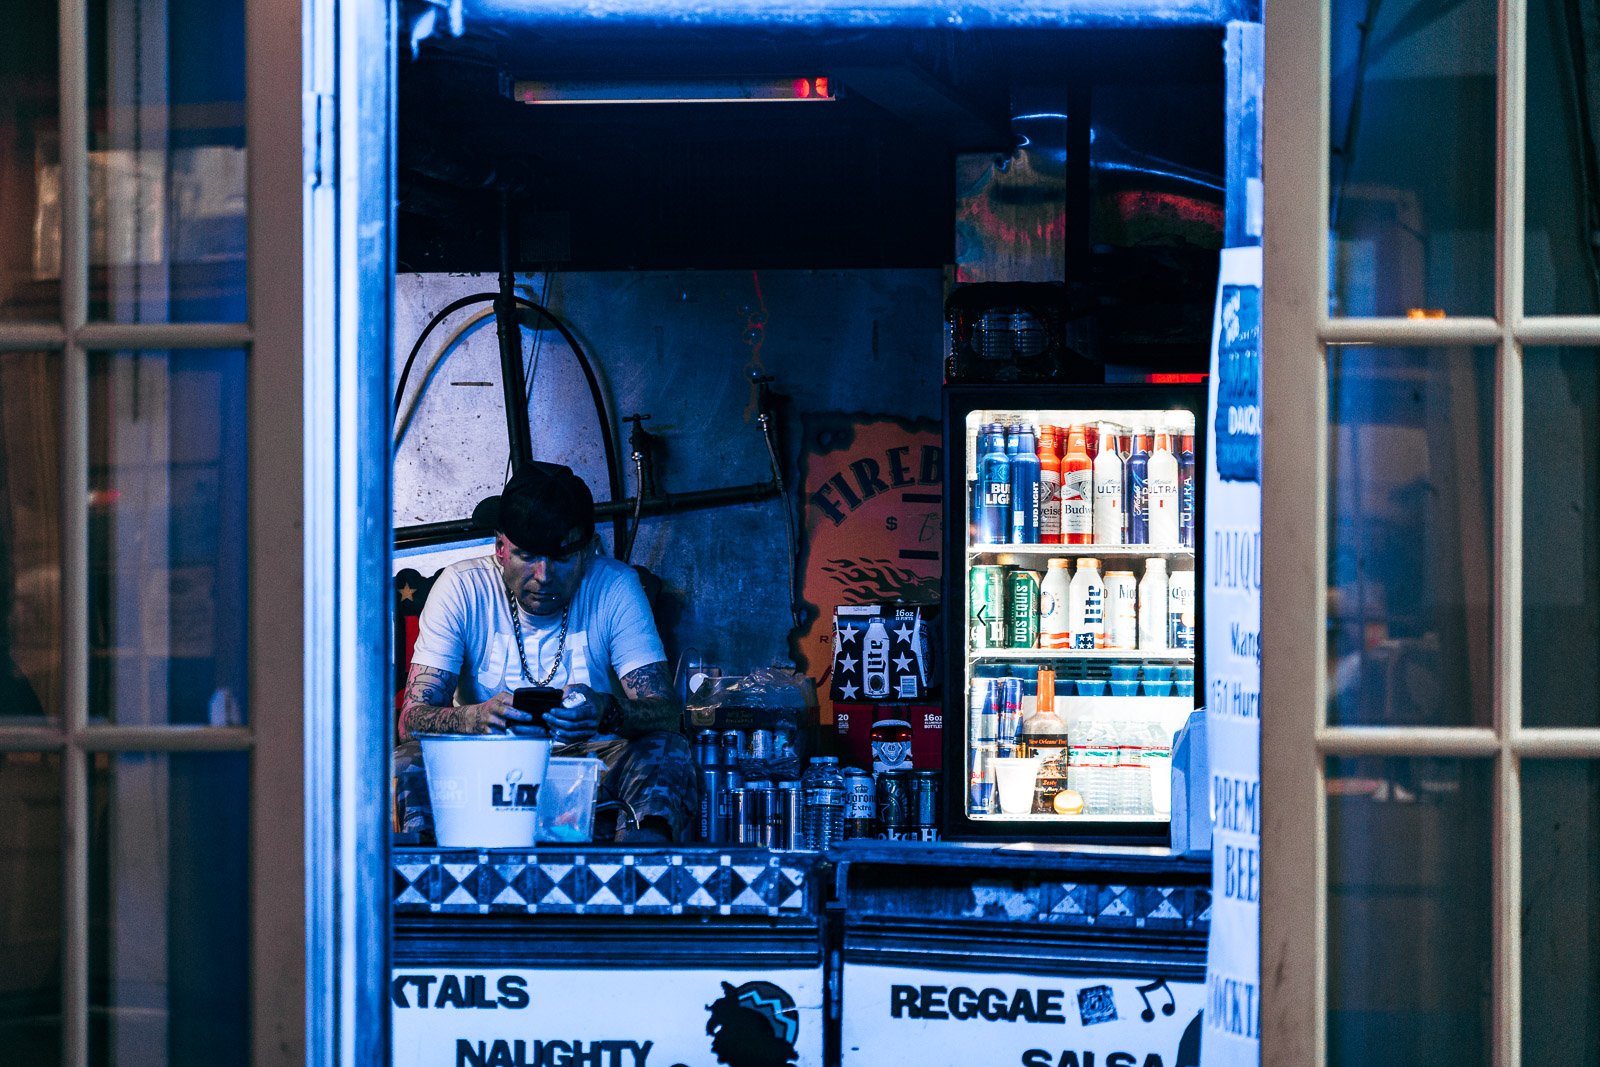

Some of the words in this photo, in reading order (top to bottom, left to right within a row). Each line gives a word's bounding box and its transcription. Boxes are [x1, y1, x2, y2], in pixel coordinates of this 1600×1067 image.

[991, 484, 1010, 494] BU
[1183, 475, 1193, 522] ULTRA
[885, 516, 898, 531] $
[895, 609, 914, 617] 16oz
[1015, 585, 1028, 618] EQUIS
[1015, 620, 1028, 642] DOS
[867, 639, 886, 674] Lite
[838, 713, 849, 721] 20
[890, 984, 1066, 1025] REGGAE
[456, 1039, 654, 1067] NAUGHTY
